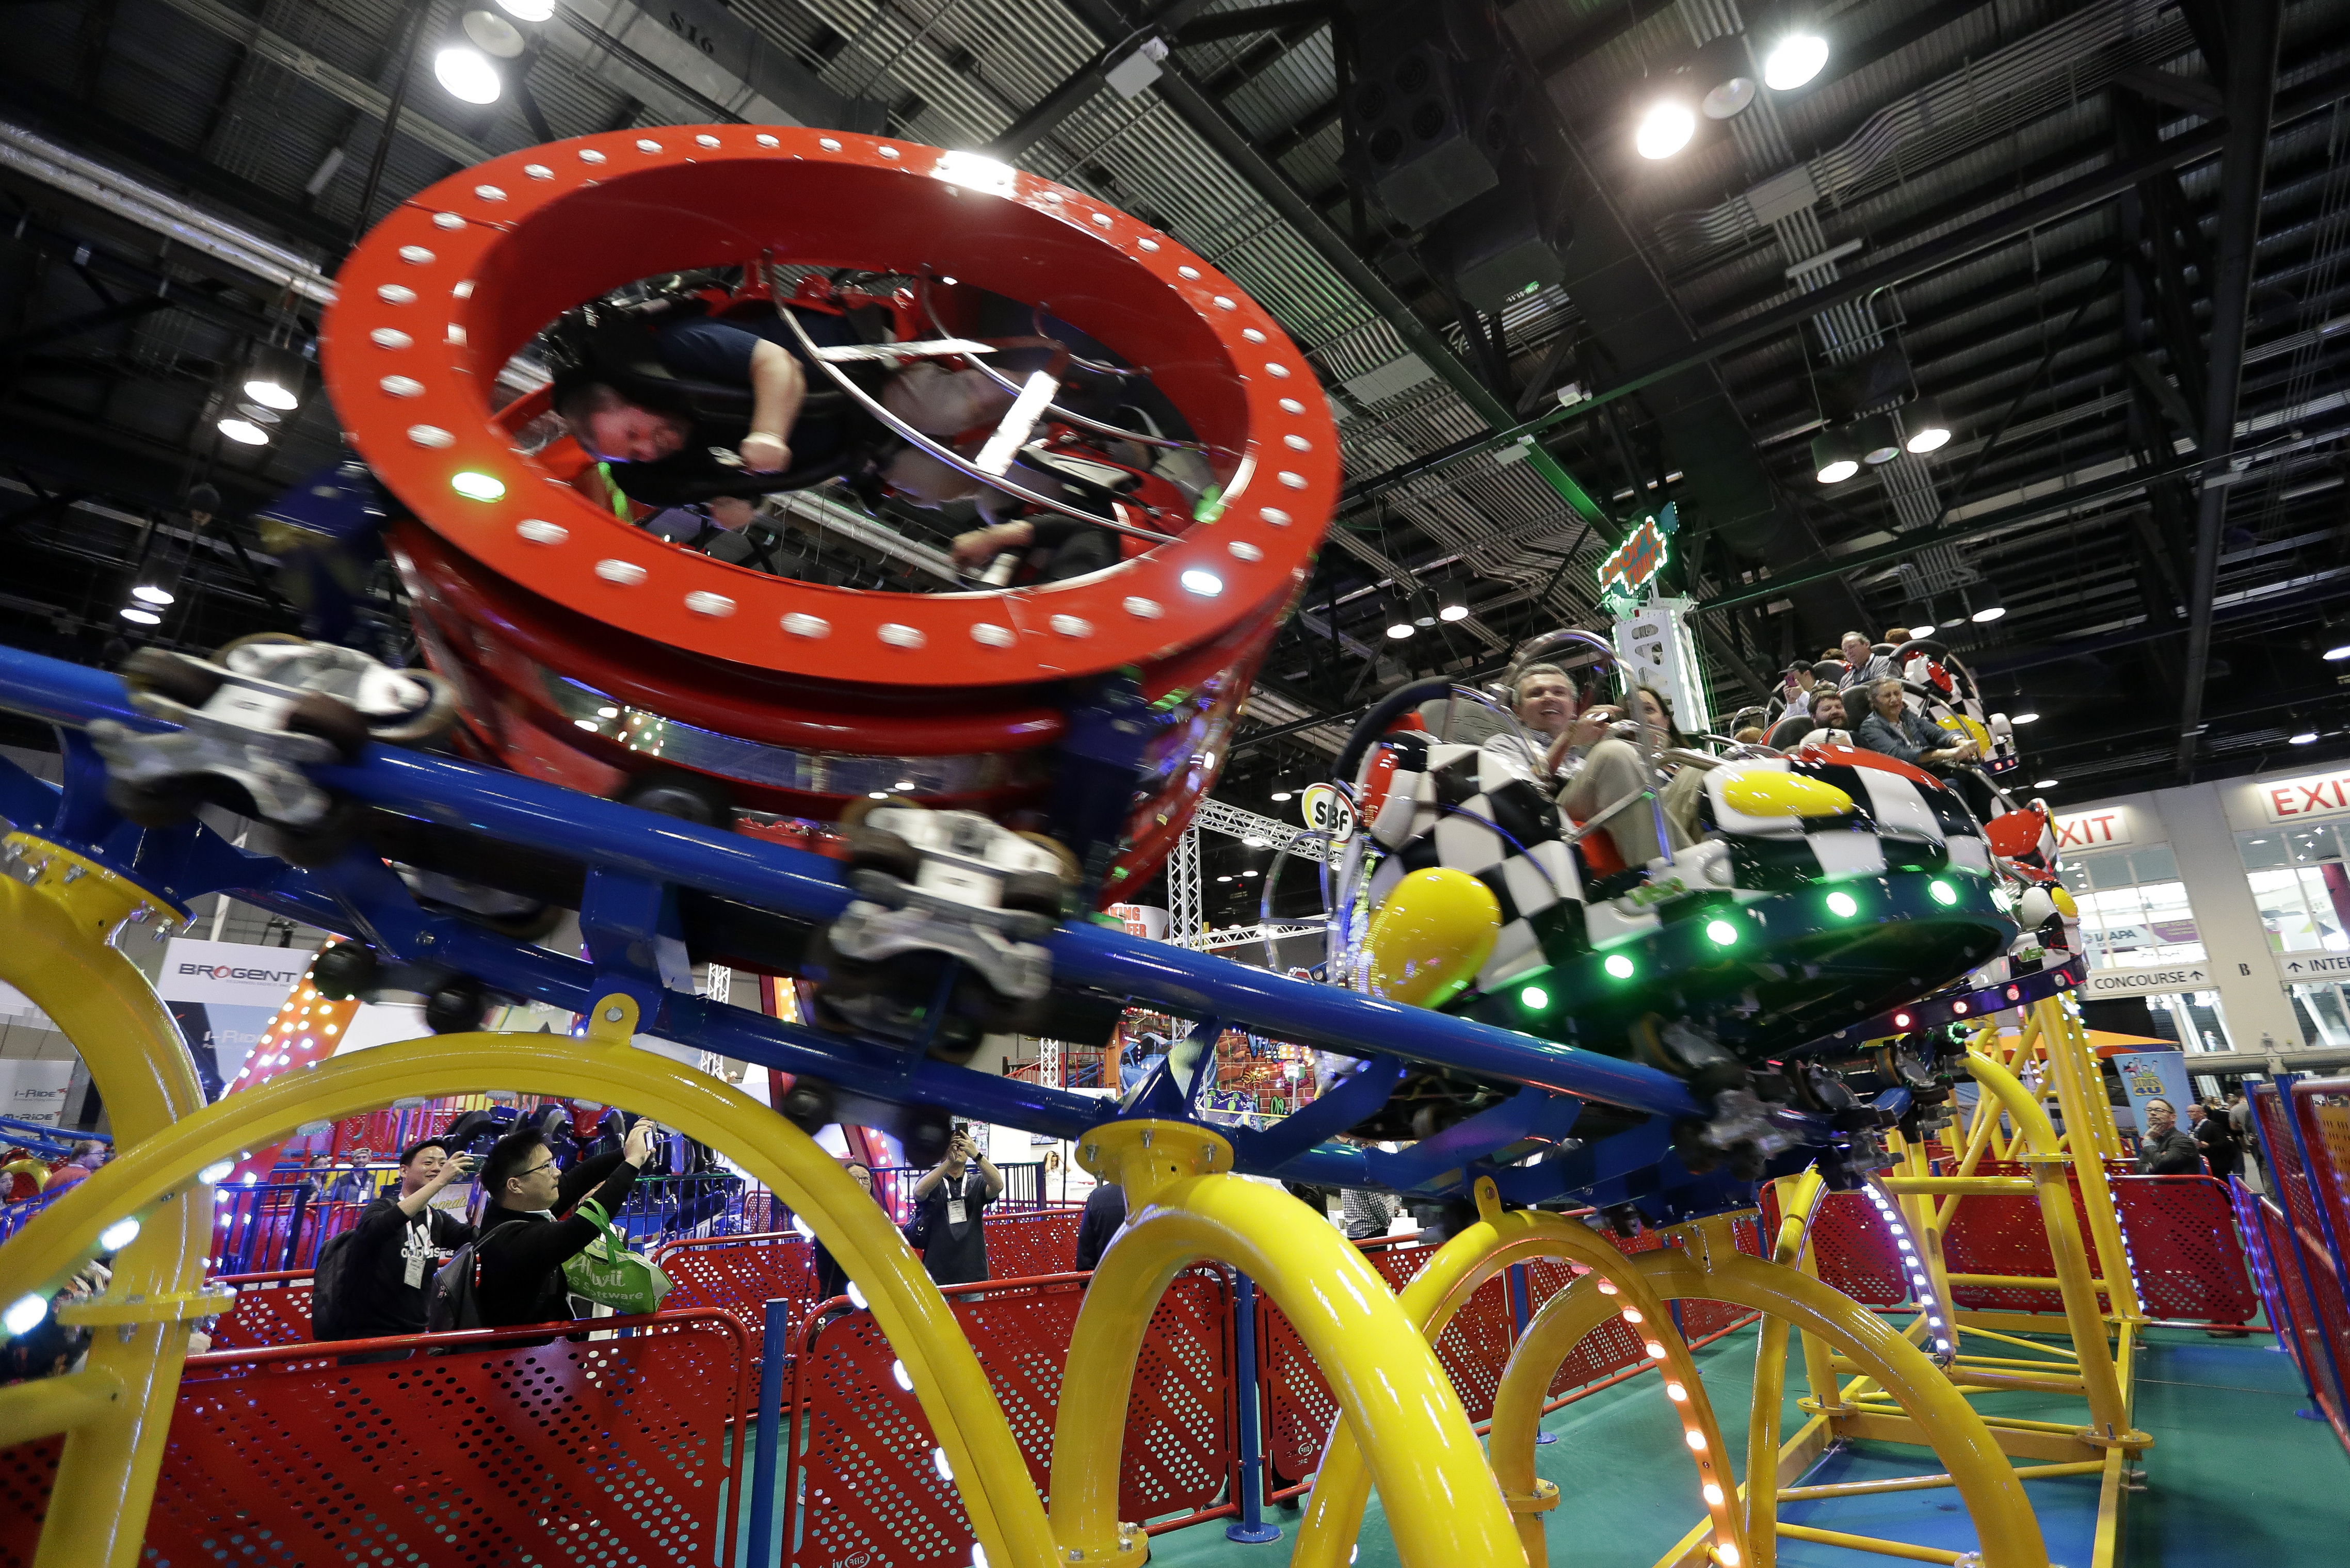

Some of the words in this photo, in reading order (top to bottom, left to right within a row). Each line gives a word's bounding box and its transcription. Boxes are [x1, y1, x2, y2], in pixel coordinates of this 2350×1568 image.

[1314, 801, 1349, 831] SBF
[2056, 815, 2115, 848] XIT
[178, 963, 297, 983] BROGENT
[2238, 963, 2251, 976] B
[2094, 971, 2187, 990] CONCOURSE
